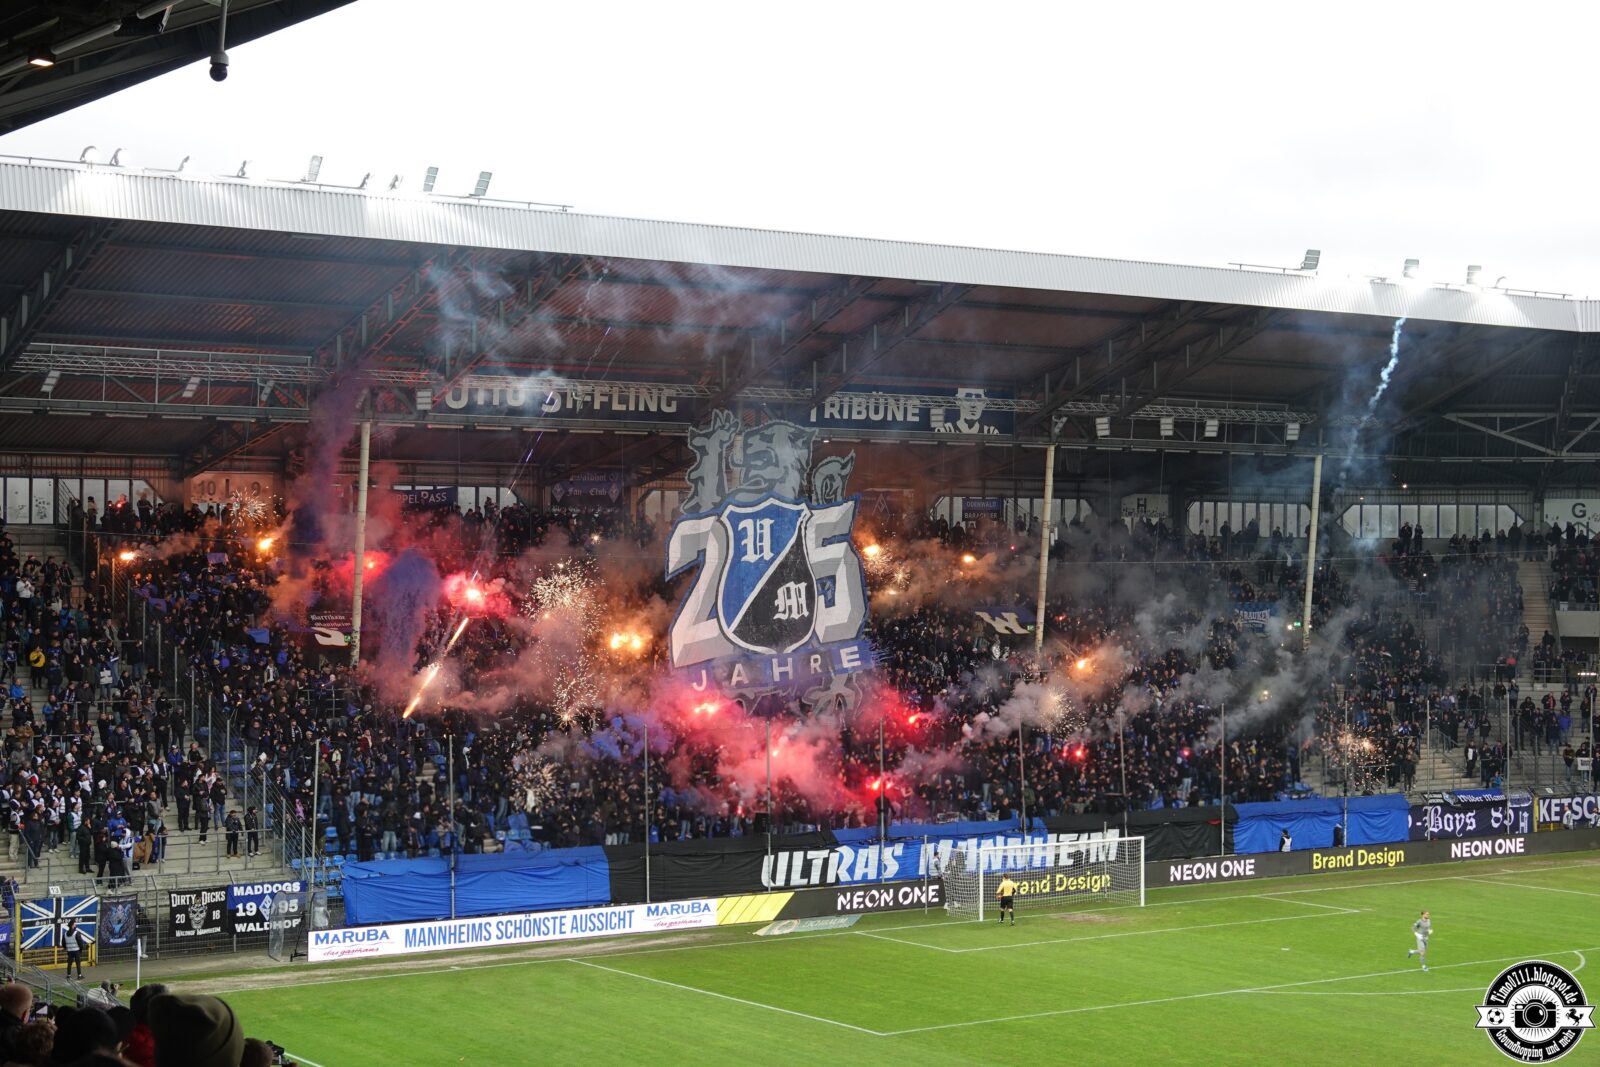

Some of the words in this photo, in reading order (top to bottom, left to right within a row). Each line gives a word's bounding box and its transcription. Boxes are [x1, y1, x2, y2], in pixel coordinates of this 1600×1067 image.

[541, 385, 677, 413] SIFFLING
[1137, 498, 1147, 515] H
[1571, 502, 1587, 519] G
[773, 581, 810, 620] M
[692, 645, 862, 692] JAHRE
[1539, 795, 1600, 824] KETSC
[1312, 849, 1354, 870] Brand
[1357, 846, 1404, 867] Design
[1451, 840, 1492, 859] NEON
[1495, 837, 1525, 855] ONE
[760, 842, 904, 888] ULTRAS
[1170, 863, 1217, 882] NEON
[1220, 859, 1256, 877] ONE
[233, 881, 301, 897] MADDOGS
[1013, 874, 1050, 896] rand
[1055, 871, 1111, 893] Design
[171, 893, 197, 908] DIRTY
[235, 901, 257, 917] 19
[278, 899, 299, 914] 95
[837, 889, 894, 911] NEON
[898, 885, 940, 906] ONE
[175, 913, 186, 924] 20
[212, 910, 221, 920] 18
[234, 918, 302, 933] WALDHOF
[404, 922, 492, 949] MANNHEIMS
[495, 913, 567, 940] SCHÖNSTE
[570, 908, 635, 936] AUSSICHT
